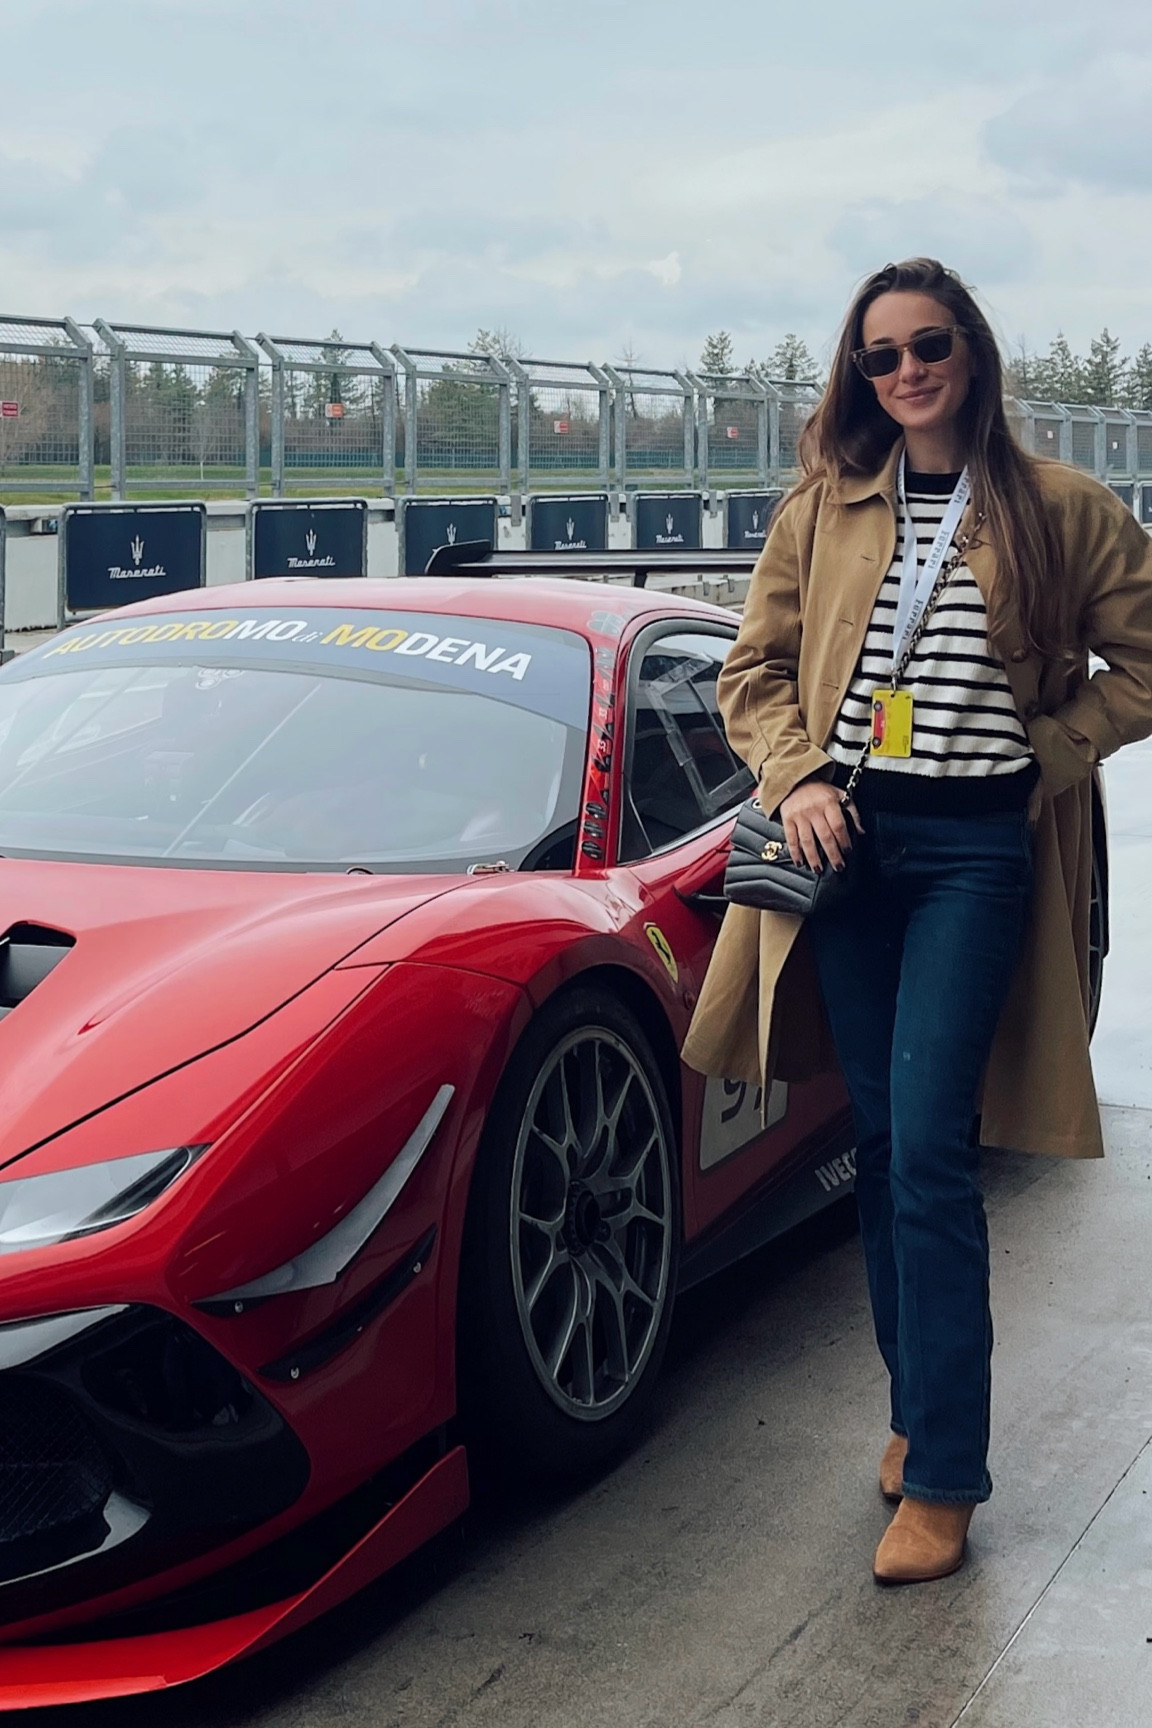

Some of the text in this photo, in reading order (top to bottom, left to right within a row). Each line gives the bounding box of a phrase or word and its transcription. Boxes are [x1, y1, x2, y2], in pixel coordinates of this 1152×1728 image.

[107, 565, 166, 579] Maserati
[287, 556, 336, 568] Maserati
[42, 620, 308, 659] AUTODROMO
[320, 624, 532, 681] MODENA
[721, 1078, 763, 1124] 9
